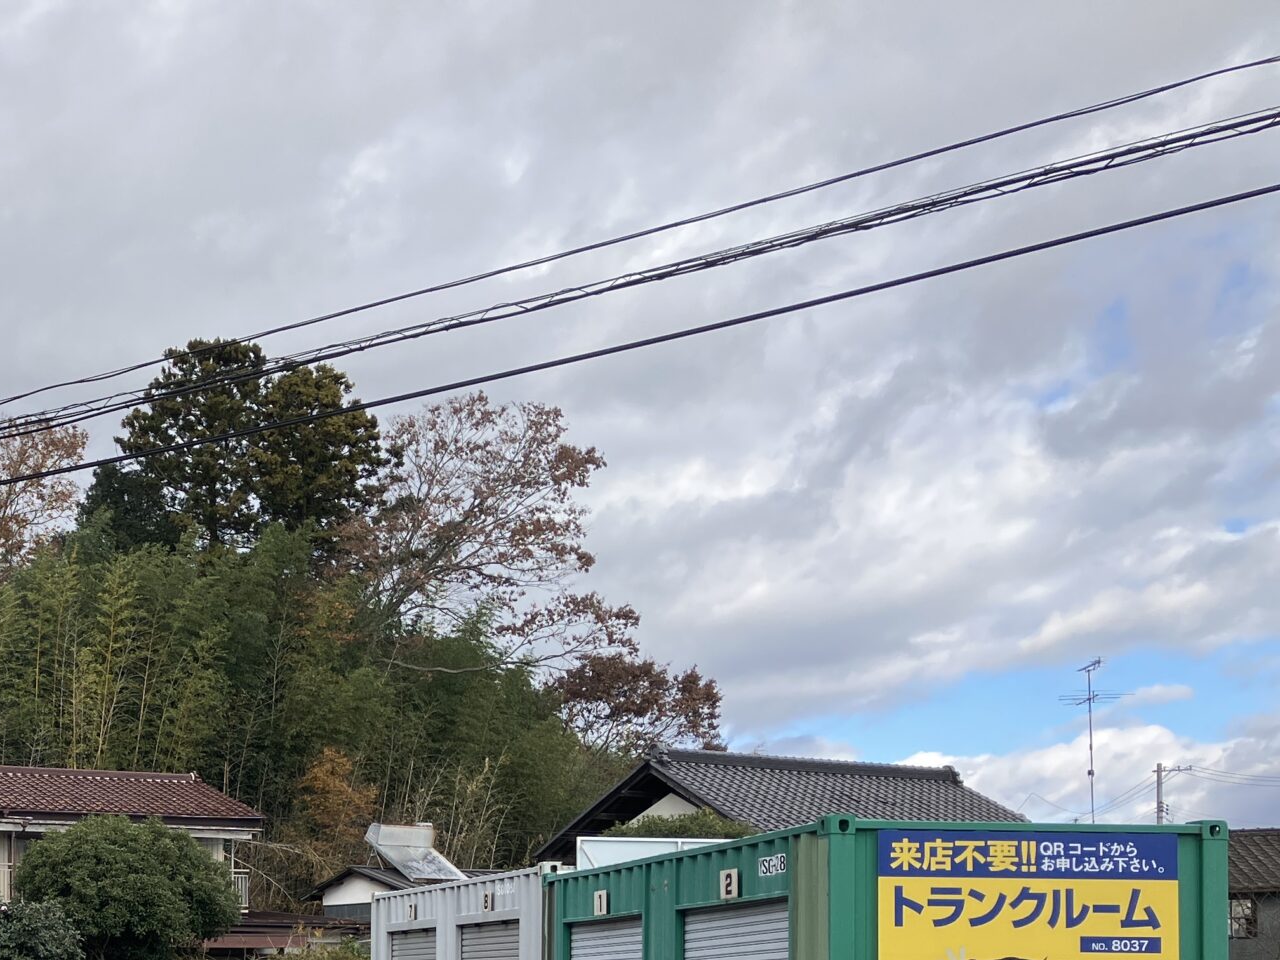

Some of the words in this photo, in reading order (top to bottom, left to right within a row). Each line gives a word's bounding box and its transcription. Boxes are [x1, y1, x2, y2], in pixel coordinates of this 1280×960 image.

[1040, 841, 1065, 856] QR
[1068, 842, 1138, 857] コードから
[1040, 856, 1165, 874] お申し込み下さい。
[724, 872, 733, 896] 2
[483, 893, 489, 910] 8
[894, 885, 1161, 930] トランクルーム
[1091, 942, 1108, 951] NO.
[1111, 939, 1149, 952] 8037
